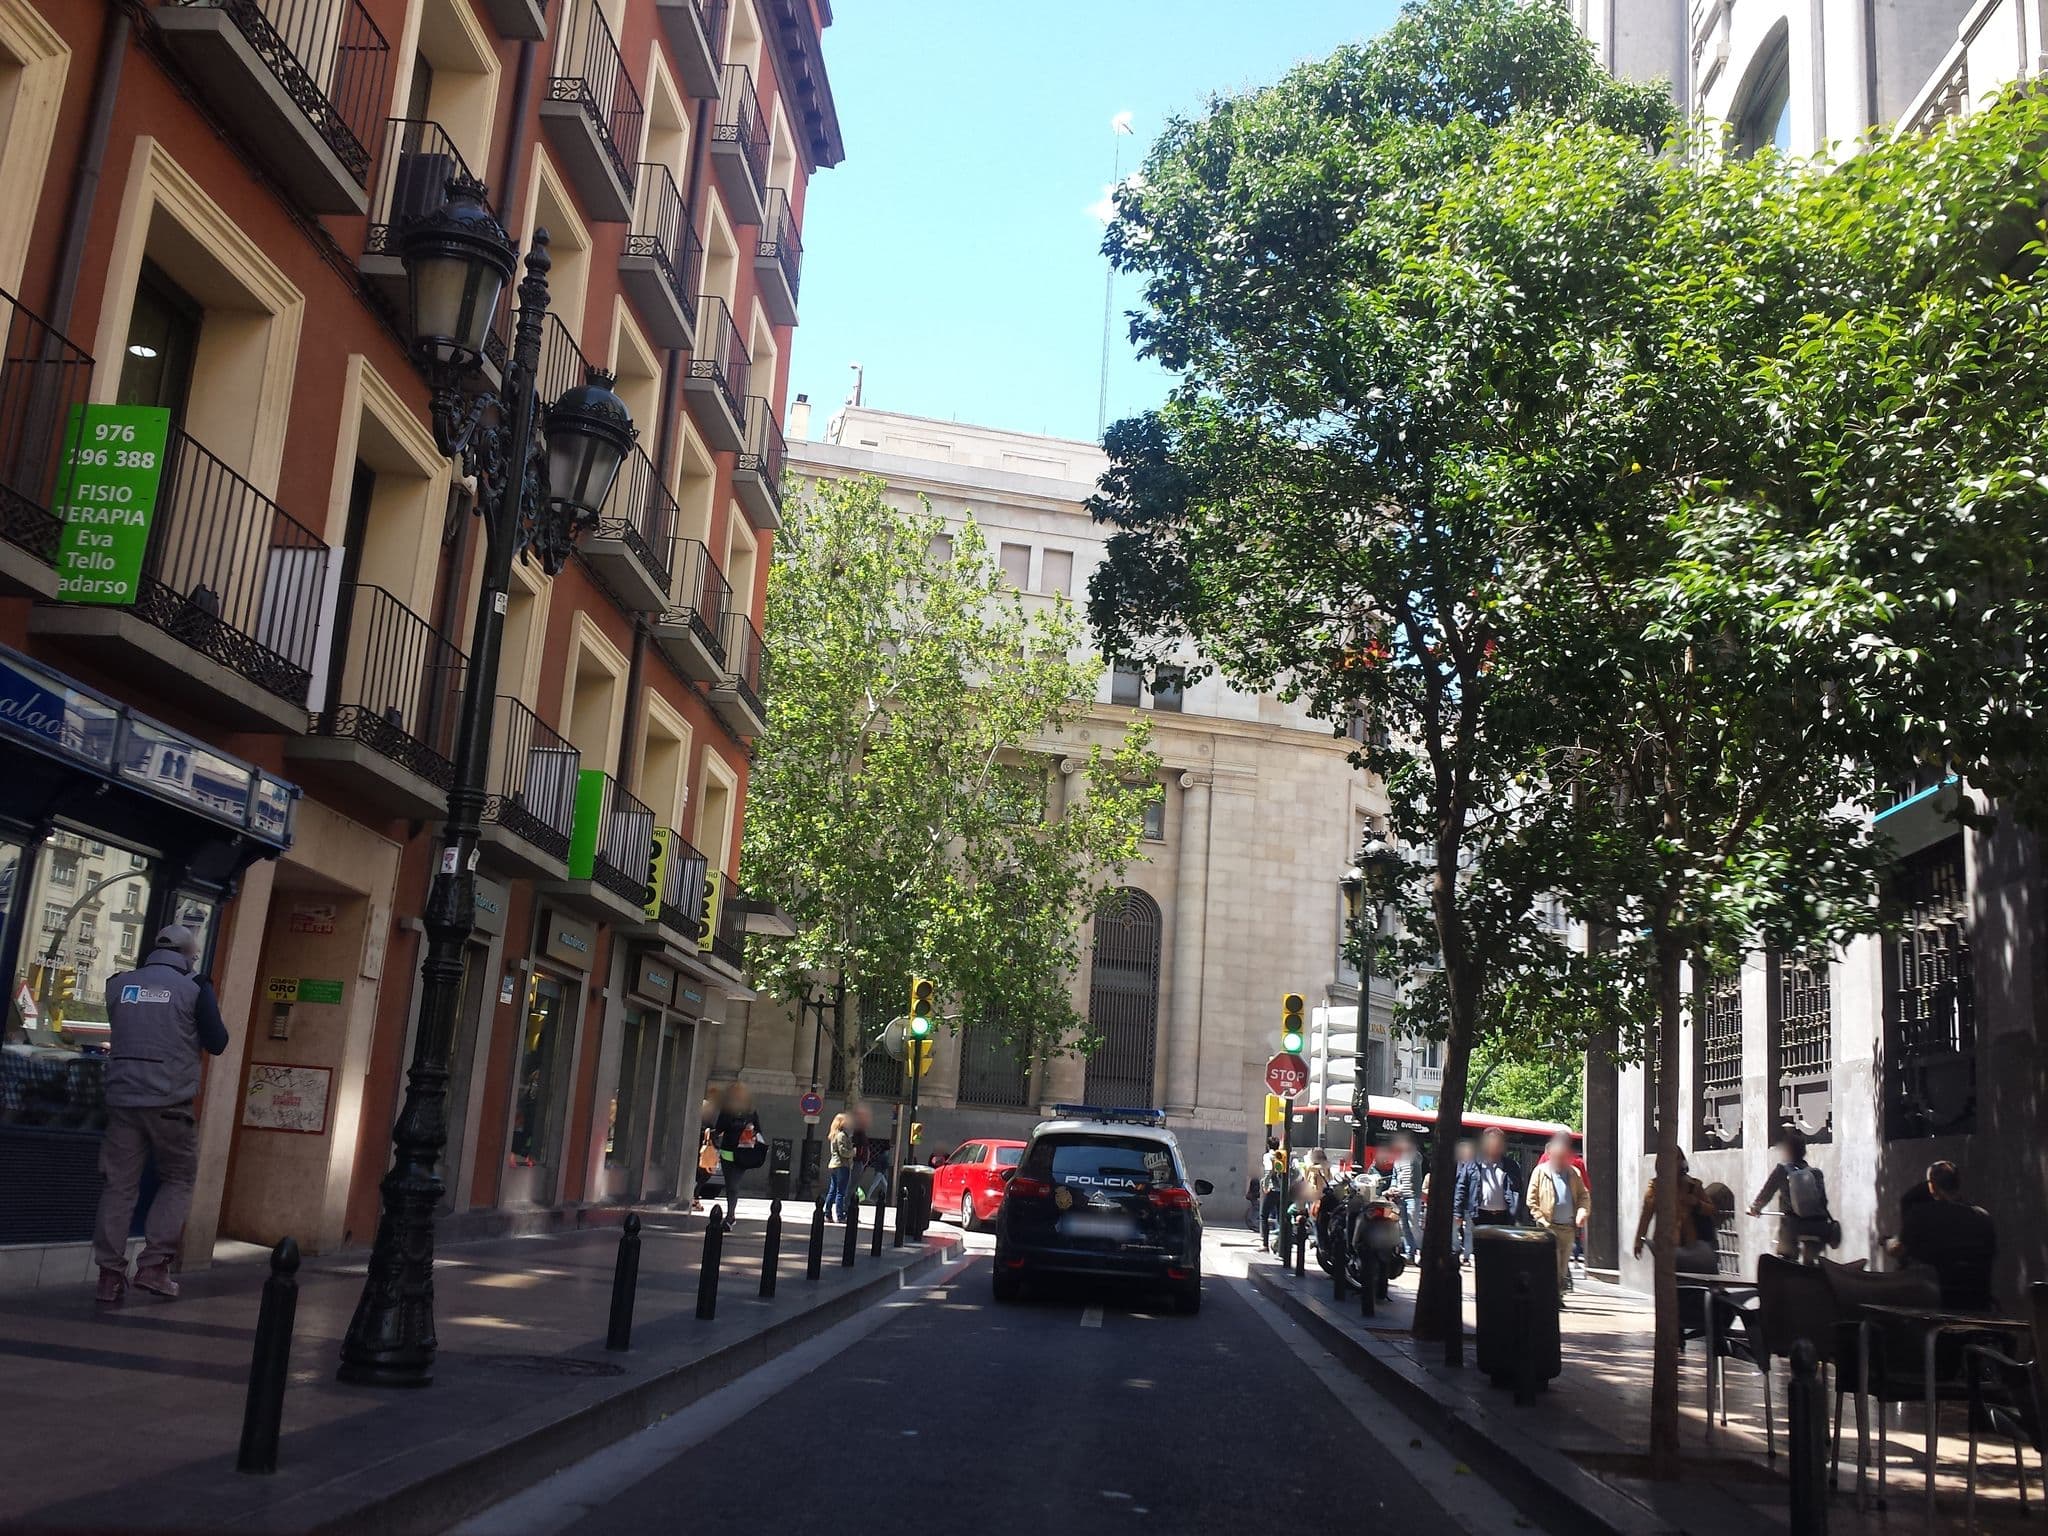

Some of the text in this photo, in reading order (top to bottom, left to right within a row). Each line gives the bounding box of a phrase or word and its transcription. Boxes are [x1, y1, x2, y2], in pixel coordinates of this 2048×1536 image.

[95, 423, 135, 442] 976
[113, 450, 155, 469] 388
[77, 484, 133, 503] FISIO
[77, 529, 113, 547] Eva
[66, 551, 116, 570] Tello
[58, 574, 128, 595] adarso
[269, 984, 296, 993] ORO
[1269, 1068, 1305, 1082] STOP
[1382, 1119, 1398, 1131] 4852
